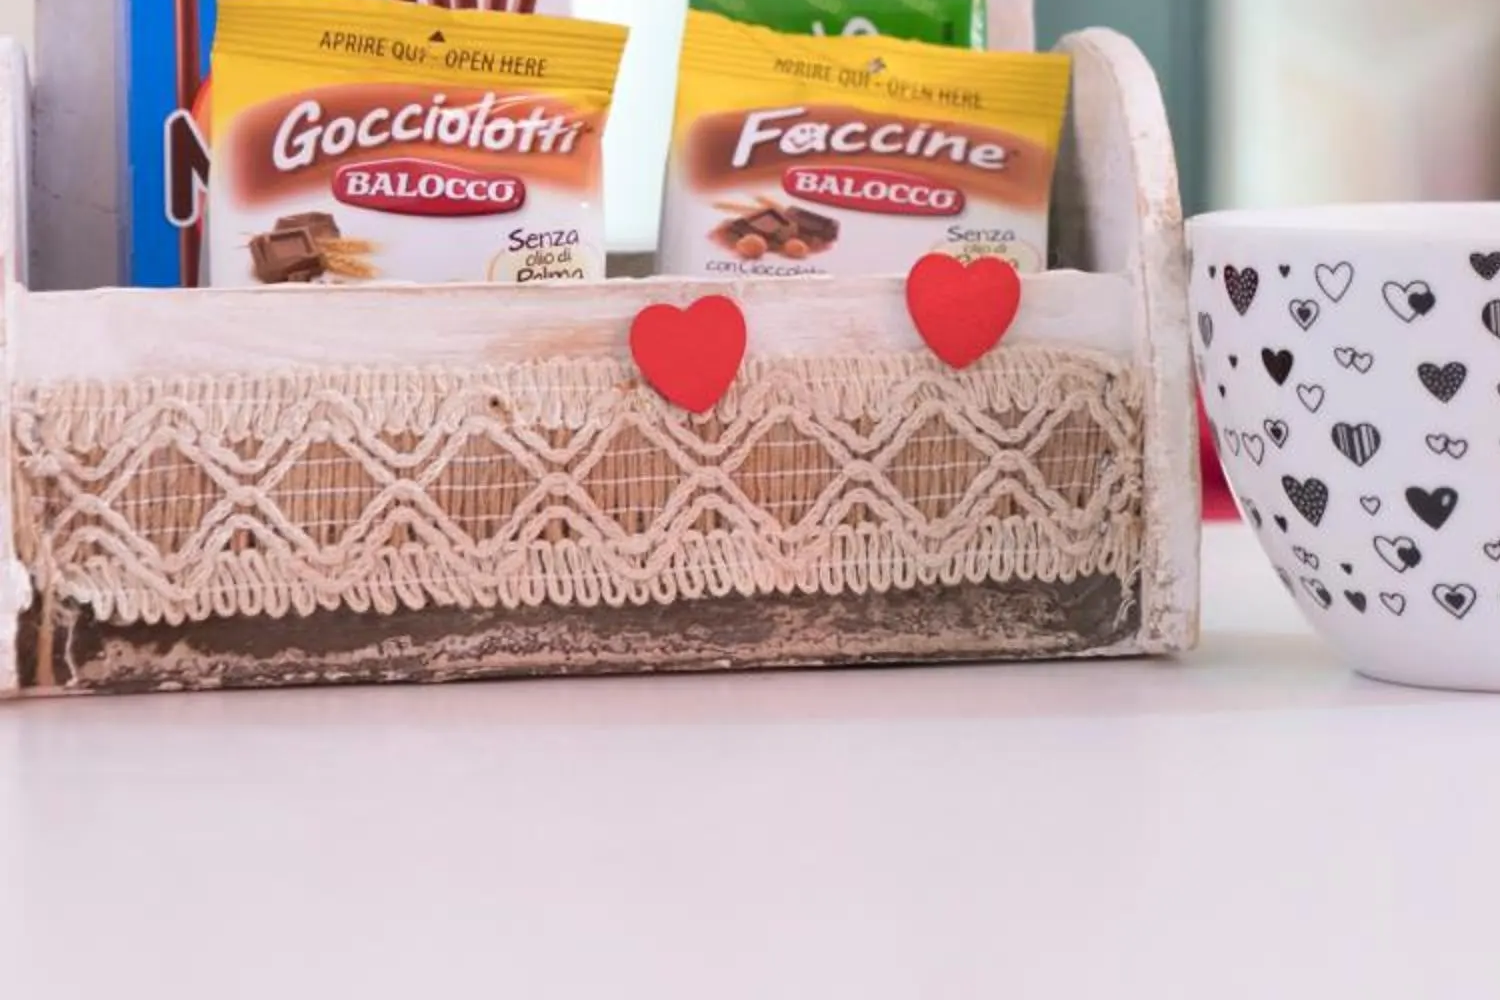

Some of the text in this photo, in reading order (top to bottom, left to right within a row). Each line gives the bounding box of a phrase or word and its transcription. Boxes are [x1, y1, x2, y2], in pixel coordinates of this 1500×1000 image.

[319, 31, 386, 57] APRIRE
[444, 49, 496, 73] OPEN
[500, 55, 549, 77] HERE
[272, 91, 583, 172] Gocciolotti
[731, 107, 1007, 170] Faccine
[346, 171, 517, 203] BALOCCO
[794, 170, 956, 210] BALOCCO
[508, 227, 579, 252] Senza
[946, 226, 1016, 243] Senza
[525, 248, 572, 267] olio di
